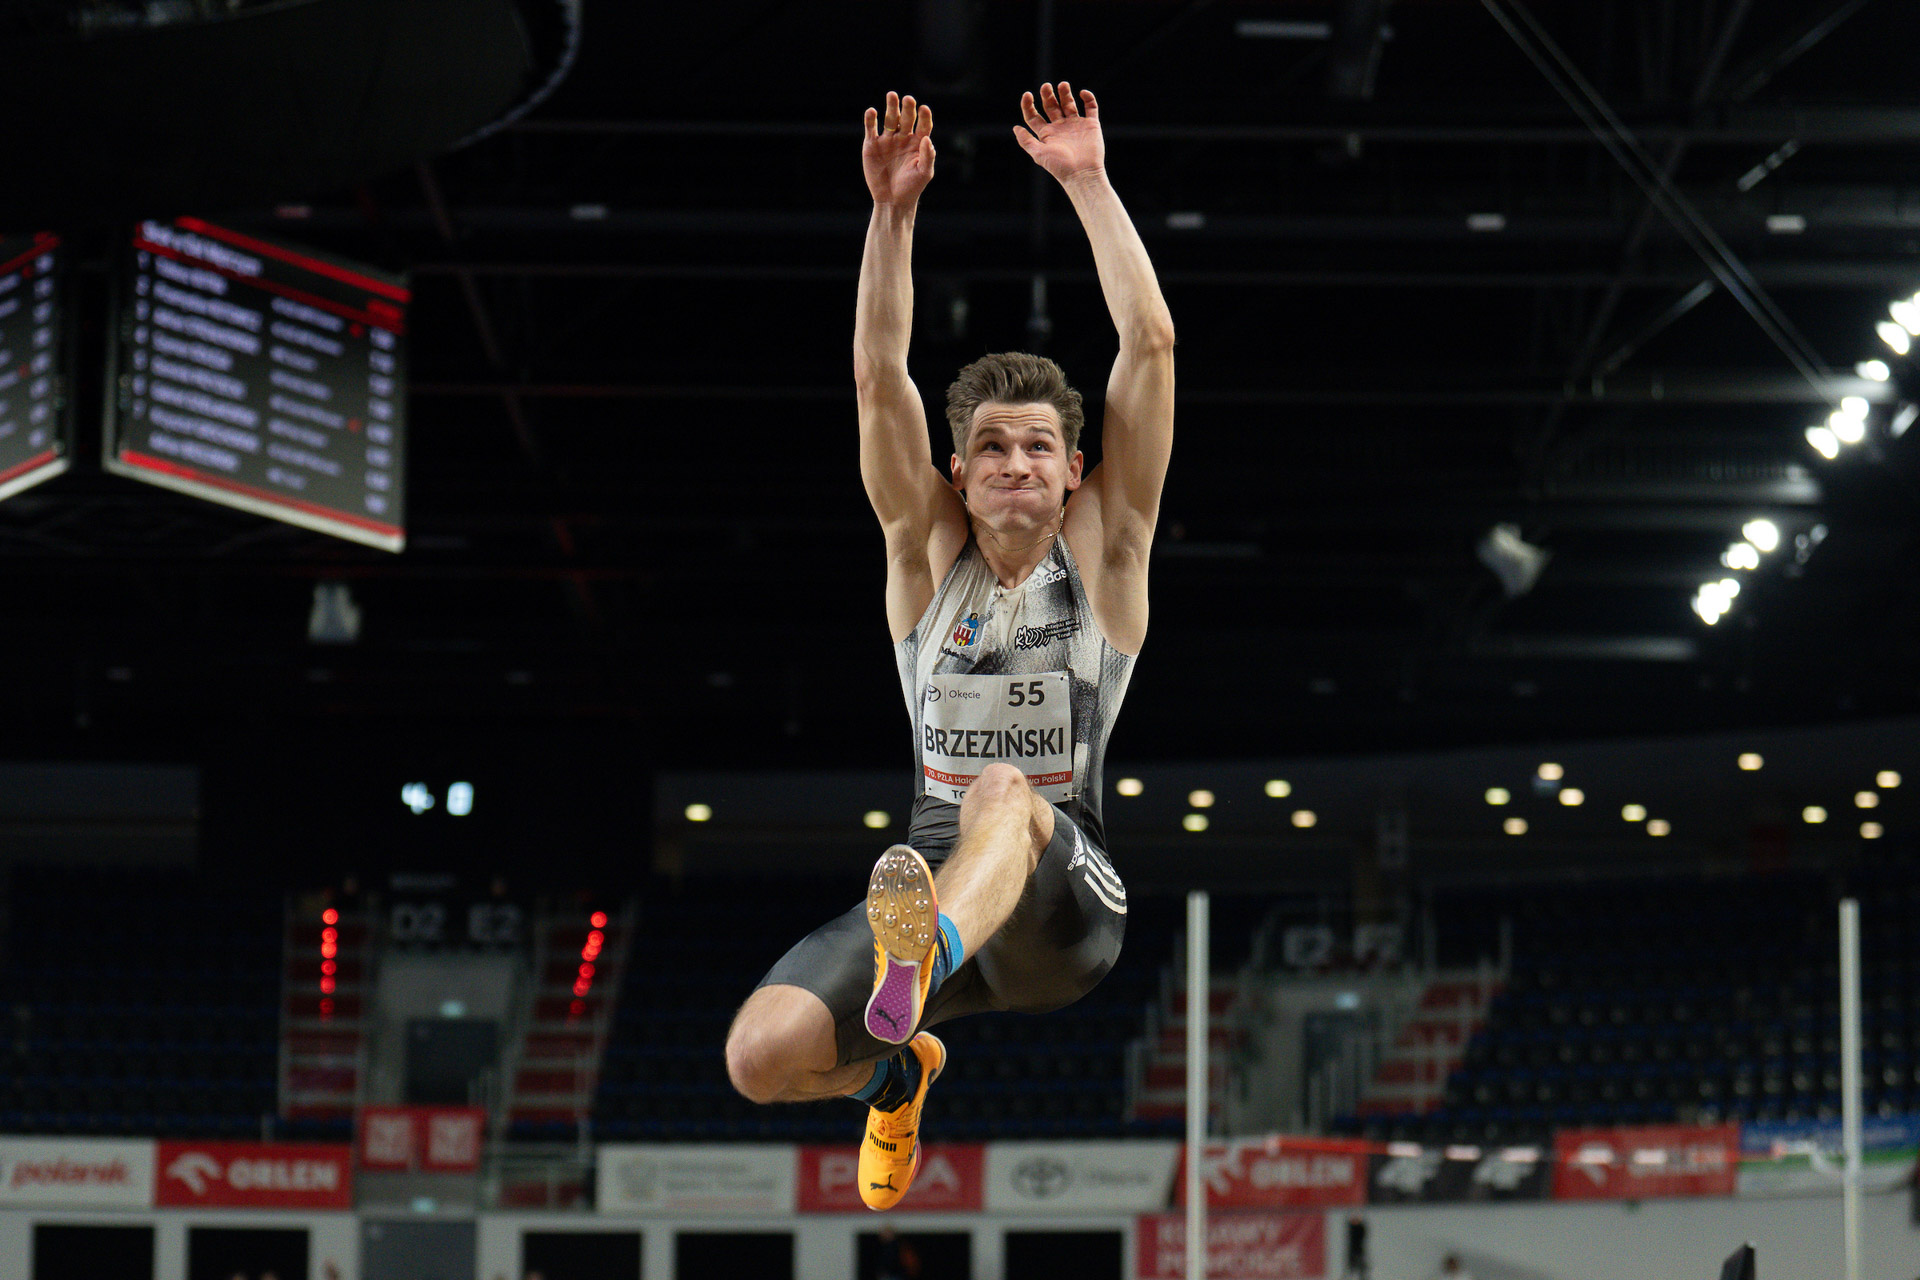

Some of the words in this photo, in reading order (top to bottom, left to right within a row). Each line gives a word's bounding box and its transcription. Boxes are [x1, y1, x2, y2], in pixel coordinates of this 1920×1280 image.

[1026, 568, 1067, 593] adidas
[949, 689, 981, 700] Okęcie
[1008, 681, 1045, 707] 55
[925, 723, 1064, 759] BRZEZIŃSKI
[928, 768, 937, 779] 70.
[937, 772, 954, 783] PZLA
[955, 776, 976, 785] Halo
[1042, 773, 1066, 784] Polski
[869, 1131, 897, 1152] PUMA
[227, 1158, 338, 1191] ORLEN
